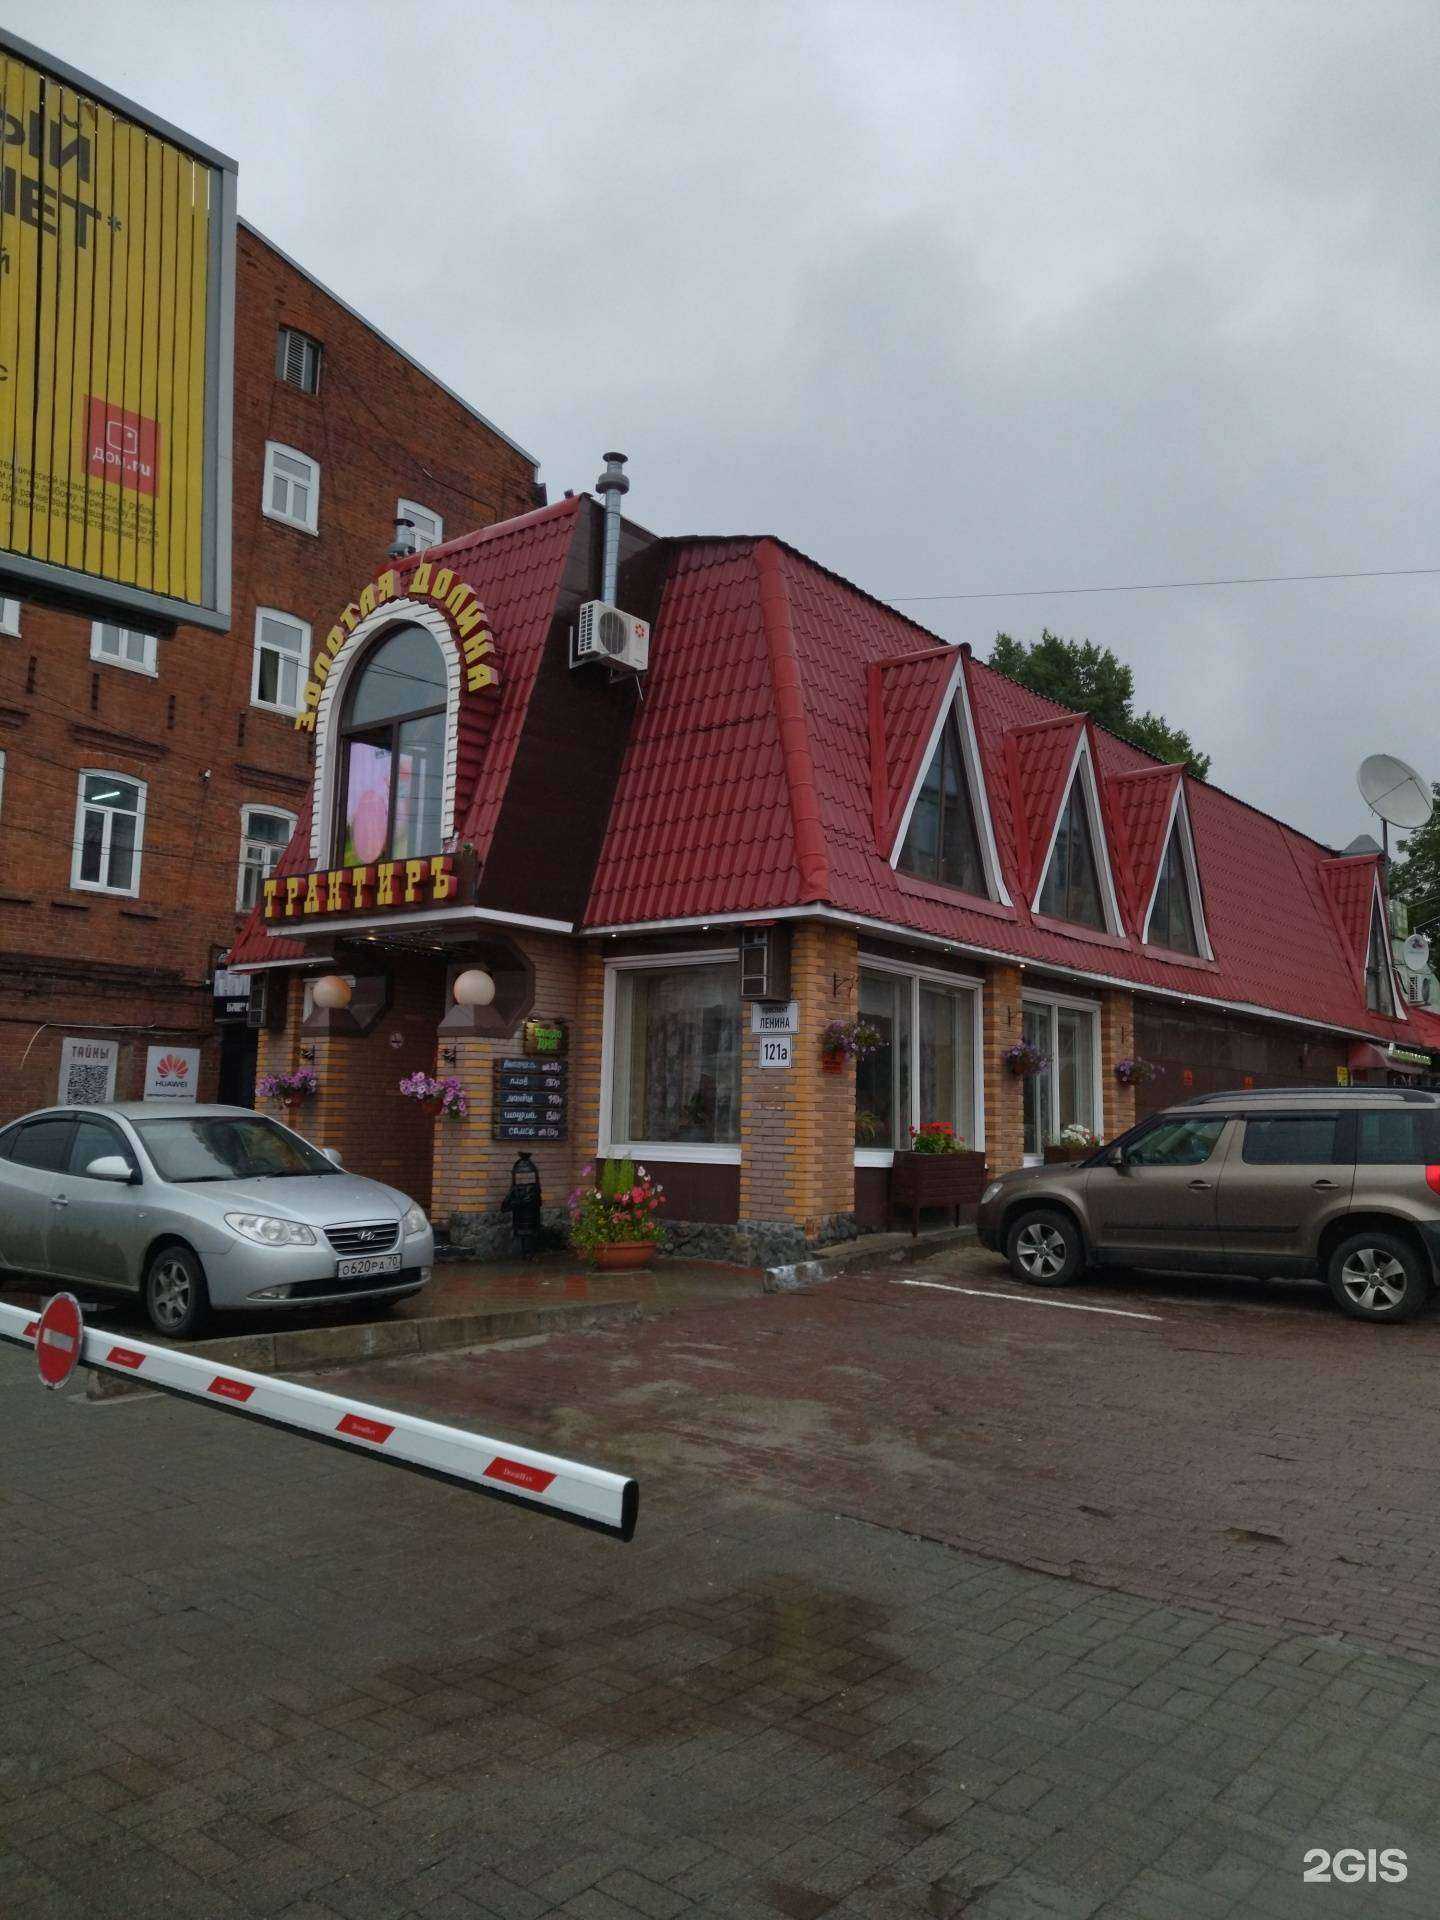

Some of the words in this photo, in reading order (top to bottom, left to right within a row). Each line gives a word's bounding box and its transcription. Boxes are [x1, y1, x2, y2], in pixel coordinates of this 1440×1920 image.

[294, 569, 397, 732] ЗОЛОТАЯ
[409, 563, 496, 692] ДОЛИНА
[760, 1017, 790, 1028] ЛЕНИНА
[72, 1044, 110, 1059] ТАЙНЫ
[764, 1043, 788, 1060] 121а
[155, 1080, 187, 1088] HUAWEI
